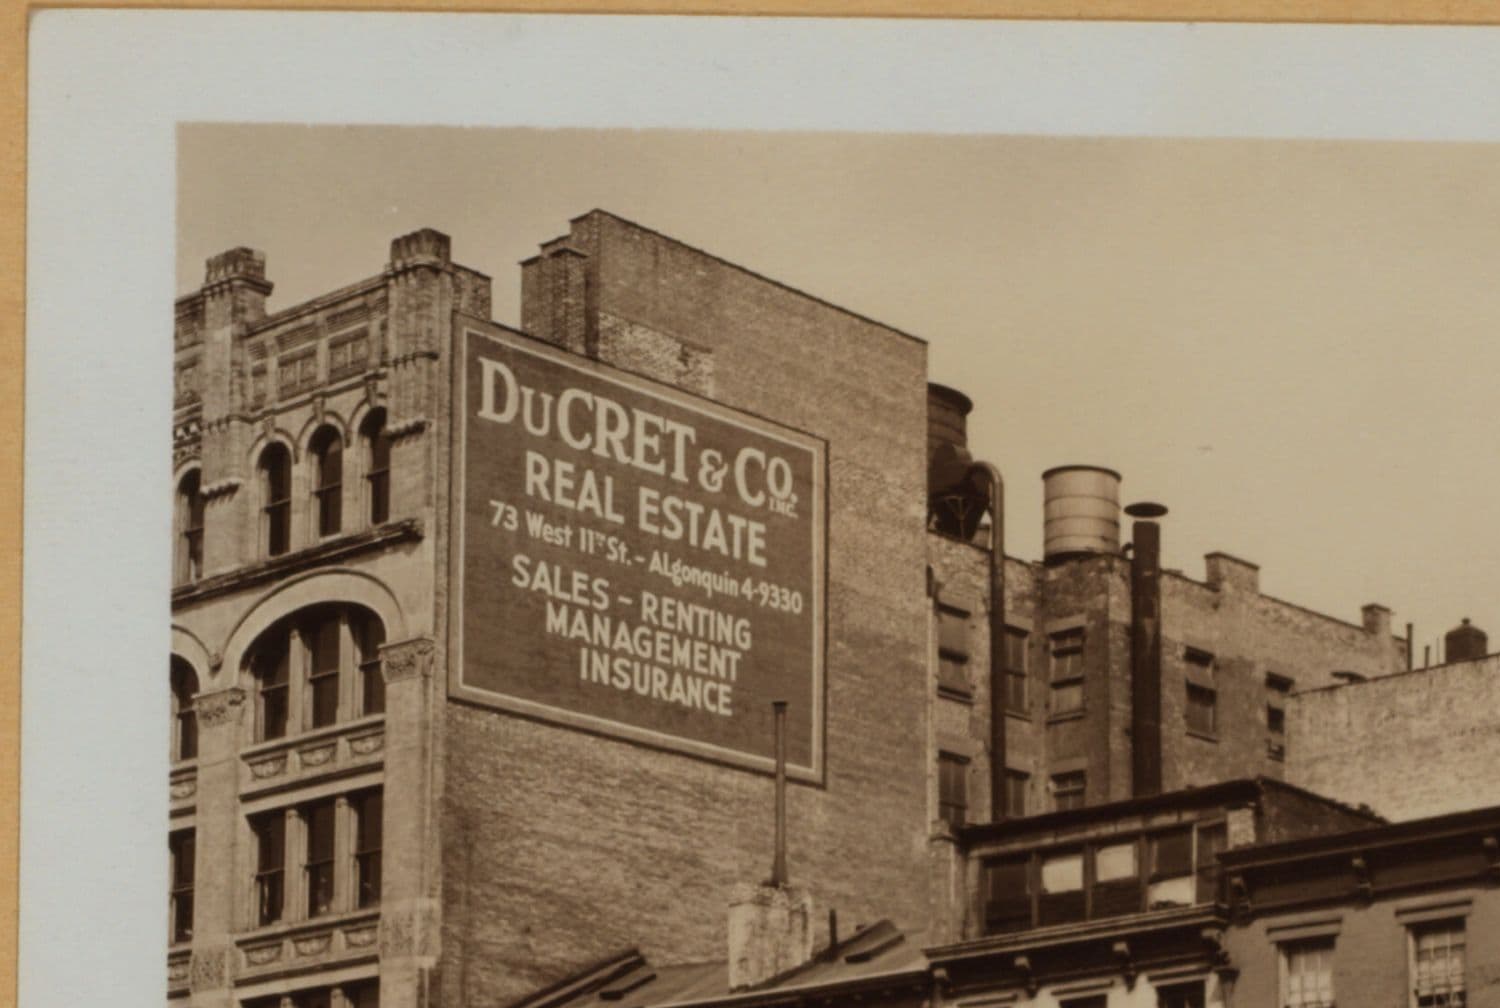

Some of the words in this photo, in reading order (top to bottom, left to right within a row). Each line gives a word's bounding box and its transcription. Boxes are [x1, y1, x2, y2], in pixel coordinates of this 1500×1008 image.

[526, 450, 625, 524] REAL
[639, 486, 767, 567] ESTATE
[699, 449, 728, 493] &
[489, 500, 519, 531] 73
[525, 510, 573, 548] West
[741, 577, 802, 615] 4-9330
[512, 554, 609, 610] SALES
[641, 591, 751, 650] RENTING
[546, 601, 741, 682] MANAGEMENT
[580, 647, 733, 716] INSURANCE
